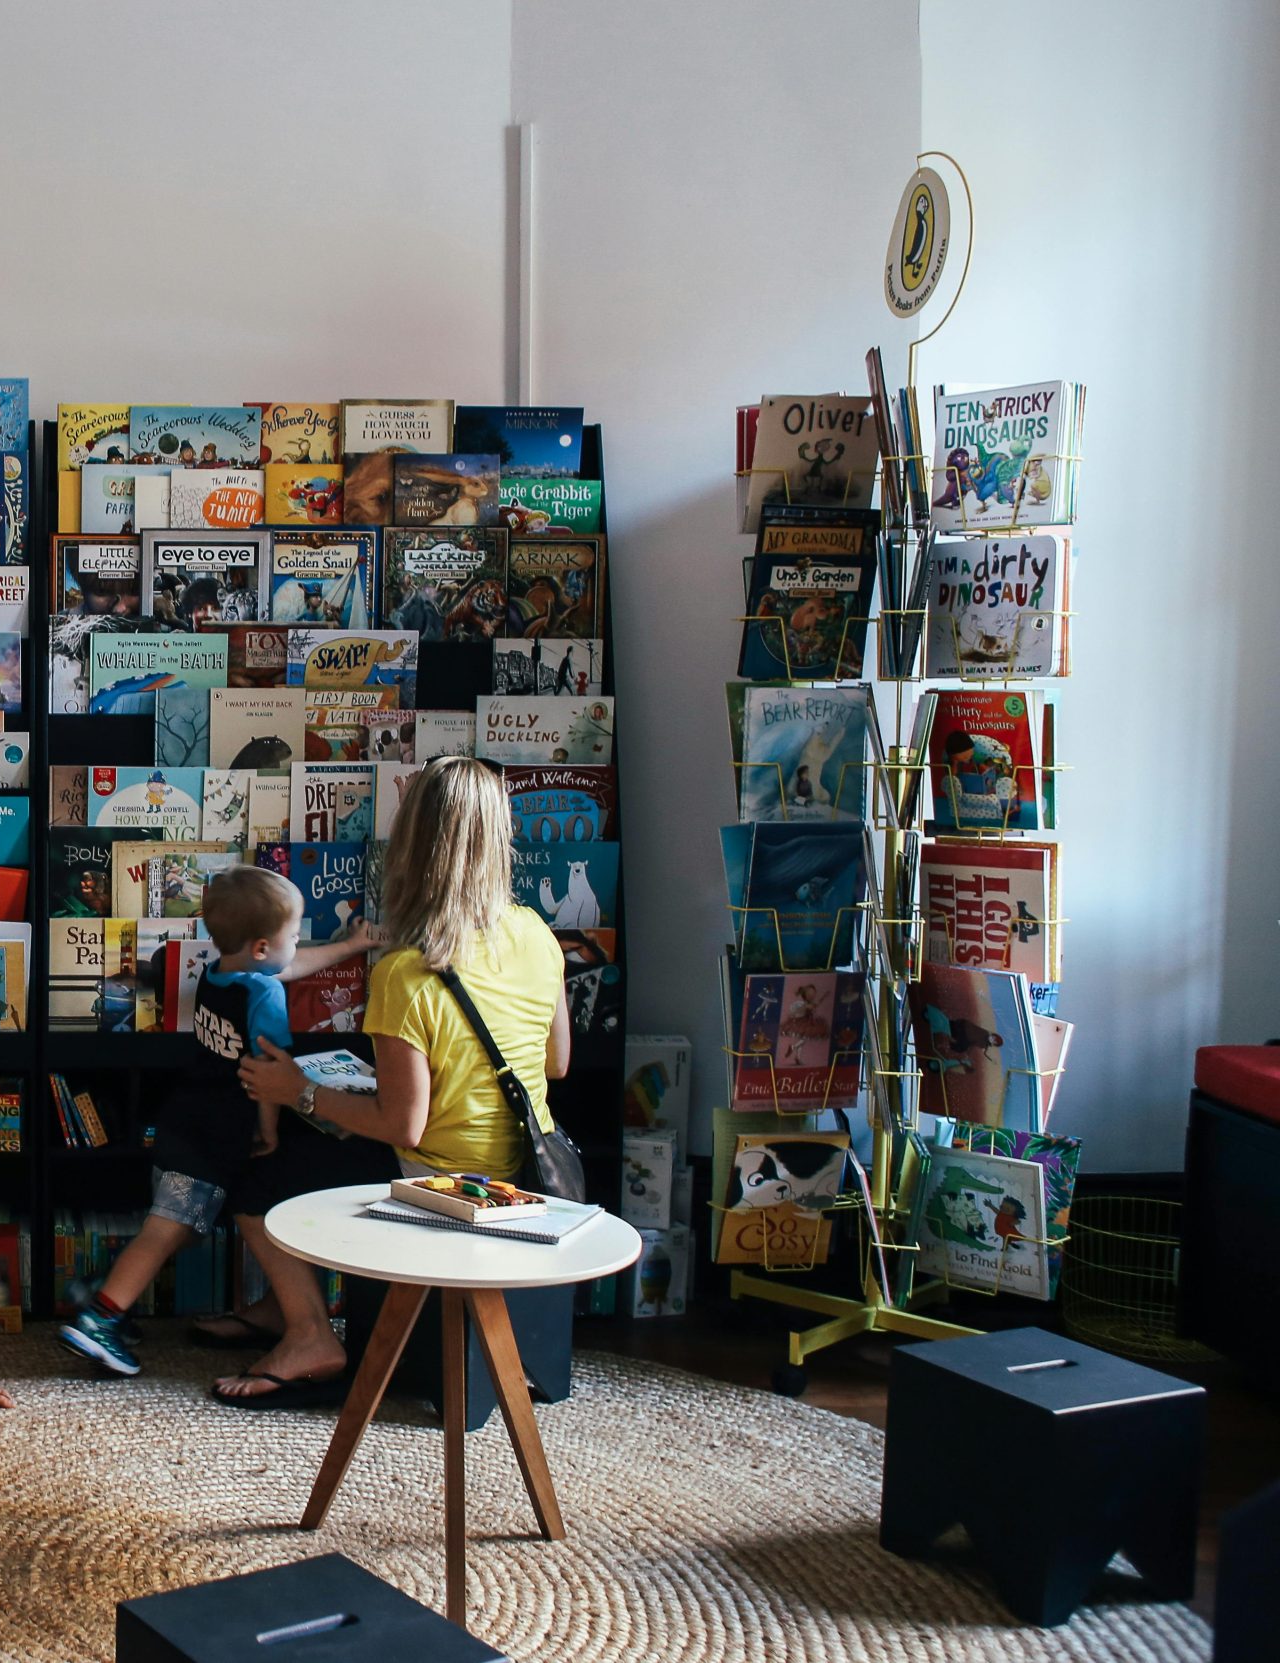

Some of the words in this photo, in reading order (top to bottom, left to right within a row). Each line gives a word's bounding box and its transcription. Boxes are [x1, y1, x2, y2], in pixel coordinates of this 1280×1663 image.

[895, 299, 912, 310] Books
[915, 286, 931, 306] from
[380, 411, 415, 419] GUESS
[945, 401, 979, 424] TEN
[995, 391, 1056, 418] TRICKY
[66, 412, 129, 446] Scarecrows
[144, 414, 159, 427] The
[365, 421, 390, 429] HOW
[395, 421, 429, 429] MUCH
[783, 402, 868, 437] Oliver
[208, 413, 256, 450] Wedding
[369, 431, 404, 439] LOVE
[408, 431, 431, 439] YOU
[944, 416, 1049, 449] DINOSAURS
[216, 491, 230, 502] THE
[236, 494, 257, 505] NEW
[532, 485, 591, 500] Grabbit
[208, 503, 255, 523] JUMPER
[552, 502, 591, 518] Tiger
[766, 531, 790, 551] MY
[792, 530, 857, 553] GRANDMA
[99, 548, 134, 558] LITTLE
[162, 548, 194, 563] eye
[198, 547, 214, 561] to
[218, 549, 250, 563] eye
[277, 556, 320, 569] Golden
[322, 556, 352, 569] Snail
[409, 552, 443, 561] LAST
[446, 551, 482, 561] KING
[776, 567, 807, 583] Uno's
[812, 569, 855, 583] Garden
[960, 559, 971, 576] A
[973, 543, 1050, 593] dirty
[938, 581, 1044, 610] DINOSAUR
[97, 653, 156, 668] WHALE
[180, 653, 225, 669] BATH
[351, 693, 378, 705] BOOK
[1011, 699, 1019, 711] 5
[487, 714, 539, 728] UGLY
[762, 702, 800, 726] BEAR
[806, 697, 864, 723] REPORT
[950, 705, 982, 720] Harry
[963, 719, 1016, 731] Dinosaurs
[486, 730, 561, 743] DUCKLING
[521, 794, 571, 814] BEAR
[115, 815, 140, 824] HOW
[144, 815, 159, 824] TO
[163, 815, 176, 824] BE
[180, 815, 188, 824] A
[322, 851, 366, 878] LUCY
[983, 874, 1010, 894] I
[955, 874, 983, 966] THIS
[983, 900, 1011, 968] GOT
[336, 967, 357, 979] and
[194, 1004, 242, 1041] STAR
[194, 1020, 244, 1060] WARS
[777, 1076, 829, 1095] Ballet
[755, 1208, 797, 1236] So
[735, 1223, 816, 1257] Cosy
[955, 1250, 968, 1263] to
[970, 1252, 998, 1270] Find
[1002, 1260, 1032, 1277] Gold
